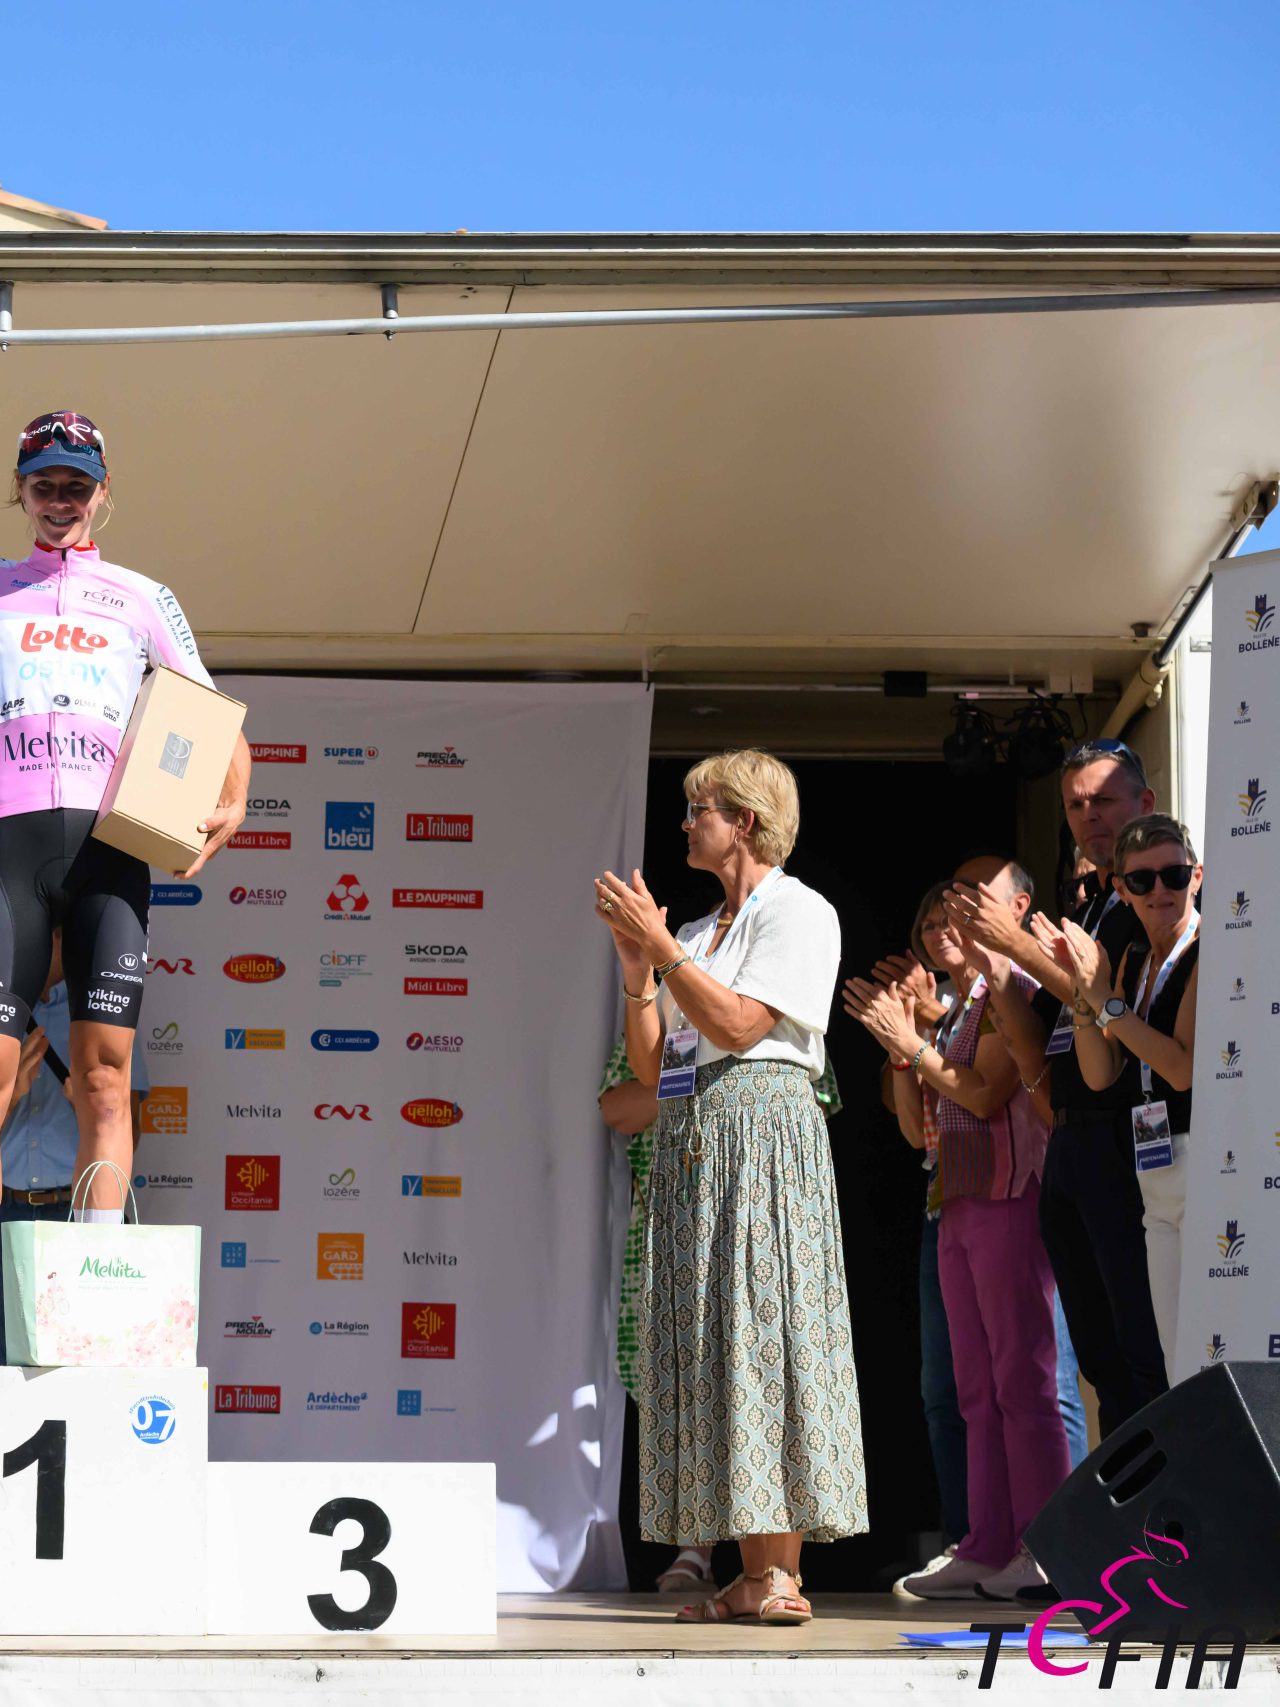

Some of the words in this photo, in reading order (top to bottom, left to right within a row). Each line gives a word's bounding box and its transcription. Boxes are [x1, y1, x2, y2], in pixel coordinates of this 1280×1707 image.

[158, 585, 195, 656] Melvita
[4, 730, 106, 762] Melvita
[324, 747, 363, 757] SUPER
[417, 751, 458, 759] PRECIA
[19, 764, 43, 772] MADE
[61, 762, 92, 772] RANCE
[245, 799, 292, 809] KODA
[410, 815, 424, 837] La
[426, 815, 469, 838] Tribune
[230, 834, 256, 845] Midi
[260, 834, 288, 846] Libre
[328, 827, 370, 847] bleu
[399, 891, 413, 902] LE
[100, 971, 143, 984] ORBEA
[408, 981, 432, 991] Midi
[435, 981, 465, 993] Libre
[87, 989, 130, 1007] viking
[87, 999, 123, 1014] lotto
[146, 1040, 184, 1051] lozère
[146, 1104, 182, 1114] GARD
[226, 1104, 282, 1118] Melvita
[148, 1175, 159, 1183] La
[160, 1174, 193, 1185] Région
[323, 1186, 361, 1197] lozère
[322, 1251, 359, 1261] GARD
[403, 1251, 458, 1266] Melvita
[79, 1255, 147, 1279] Melvita
[225, 1321, 265, 1329] PRECIA
[324, 1321, 335, 1330] La
[337, 1321, 369, 1332] Région
[407, 1344, 449, 1353] Occitanie
[218, 1387, 232, 1409] La
[234, 1387, 277, 1409] Tribune
[306, 1391, 361, 1404] Ardèche
[3, 1420, 67, 1560] 1
[307, 1497, 398, 1632] 3
